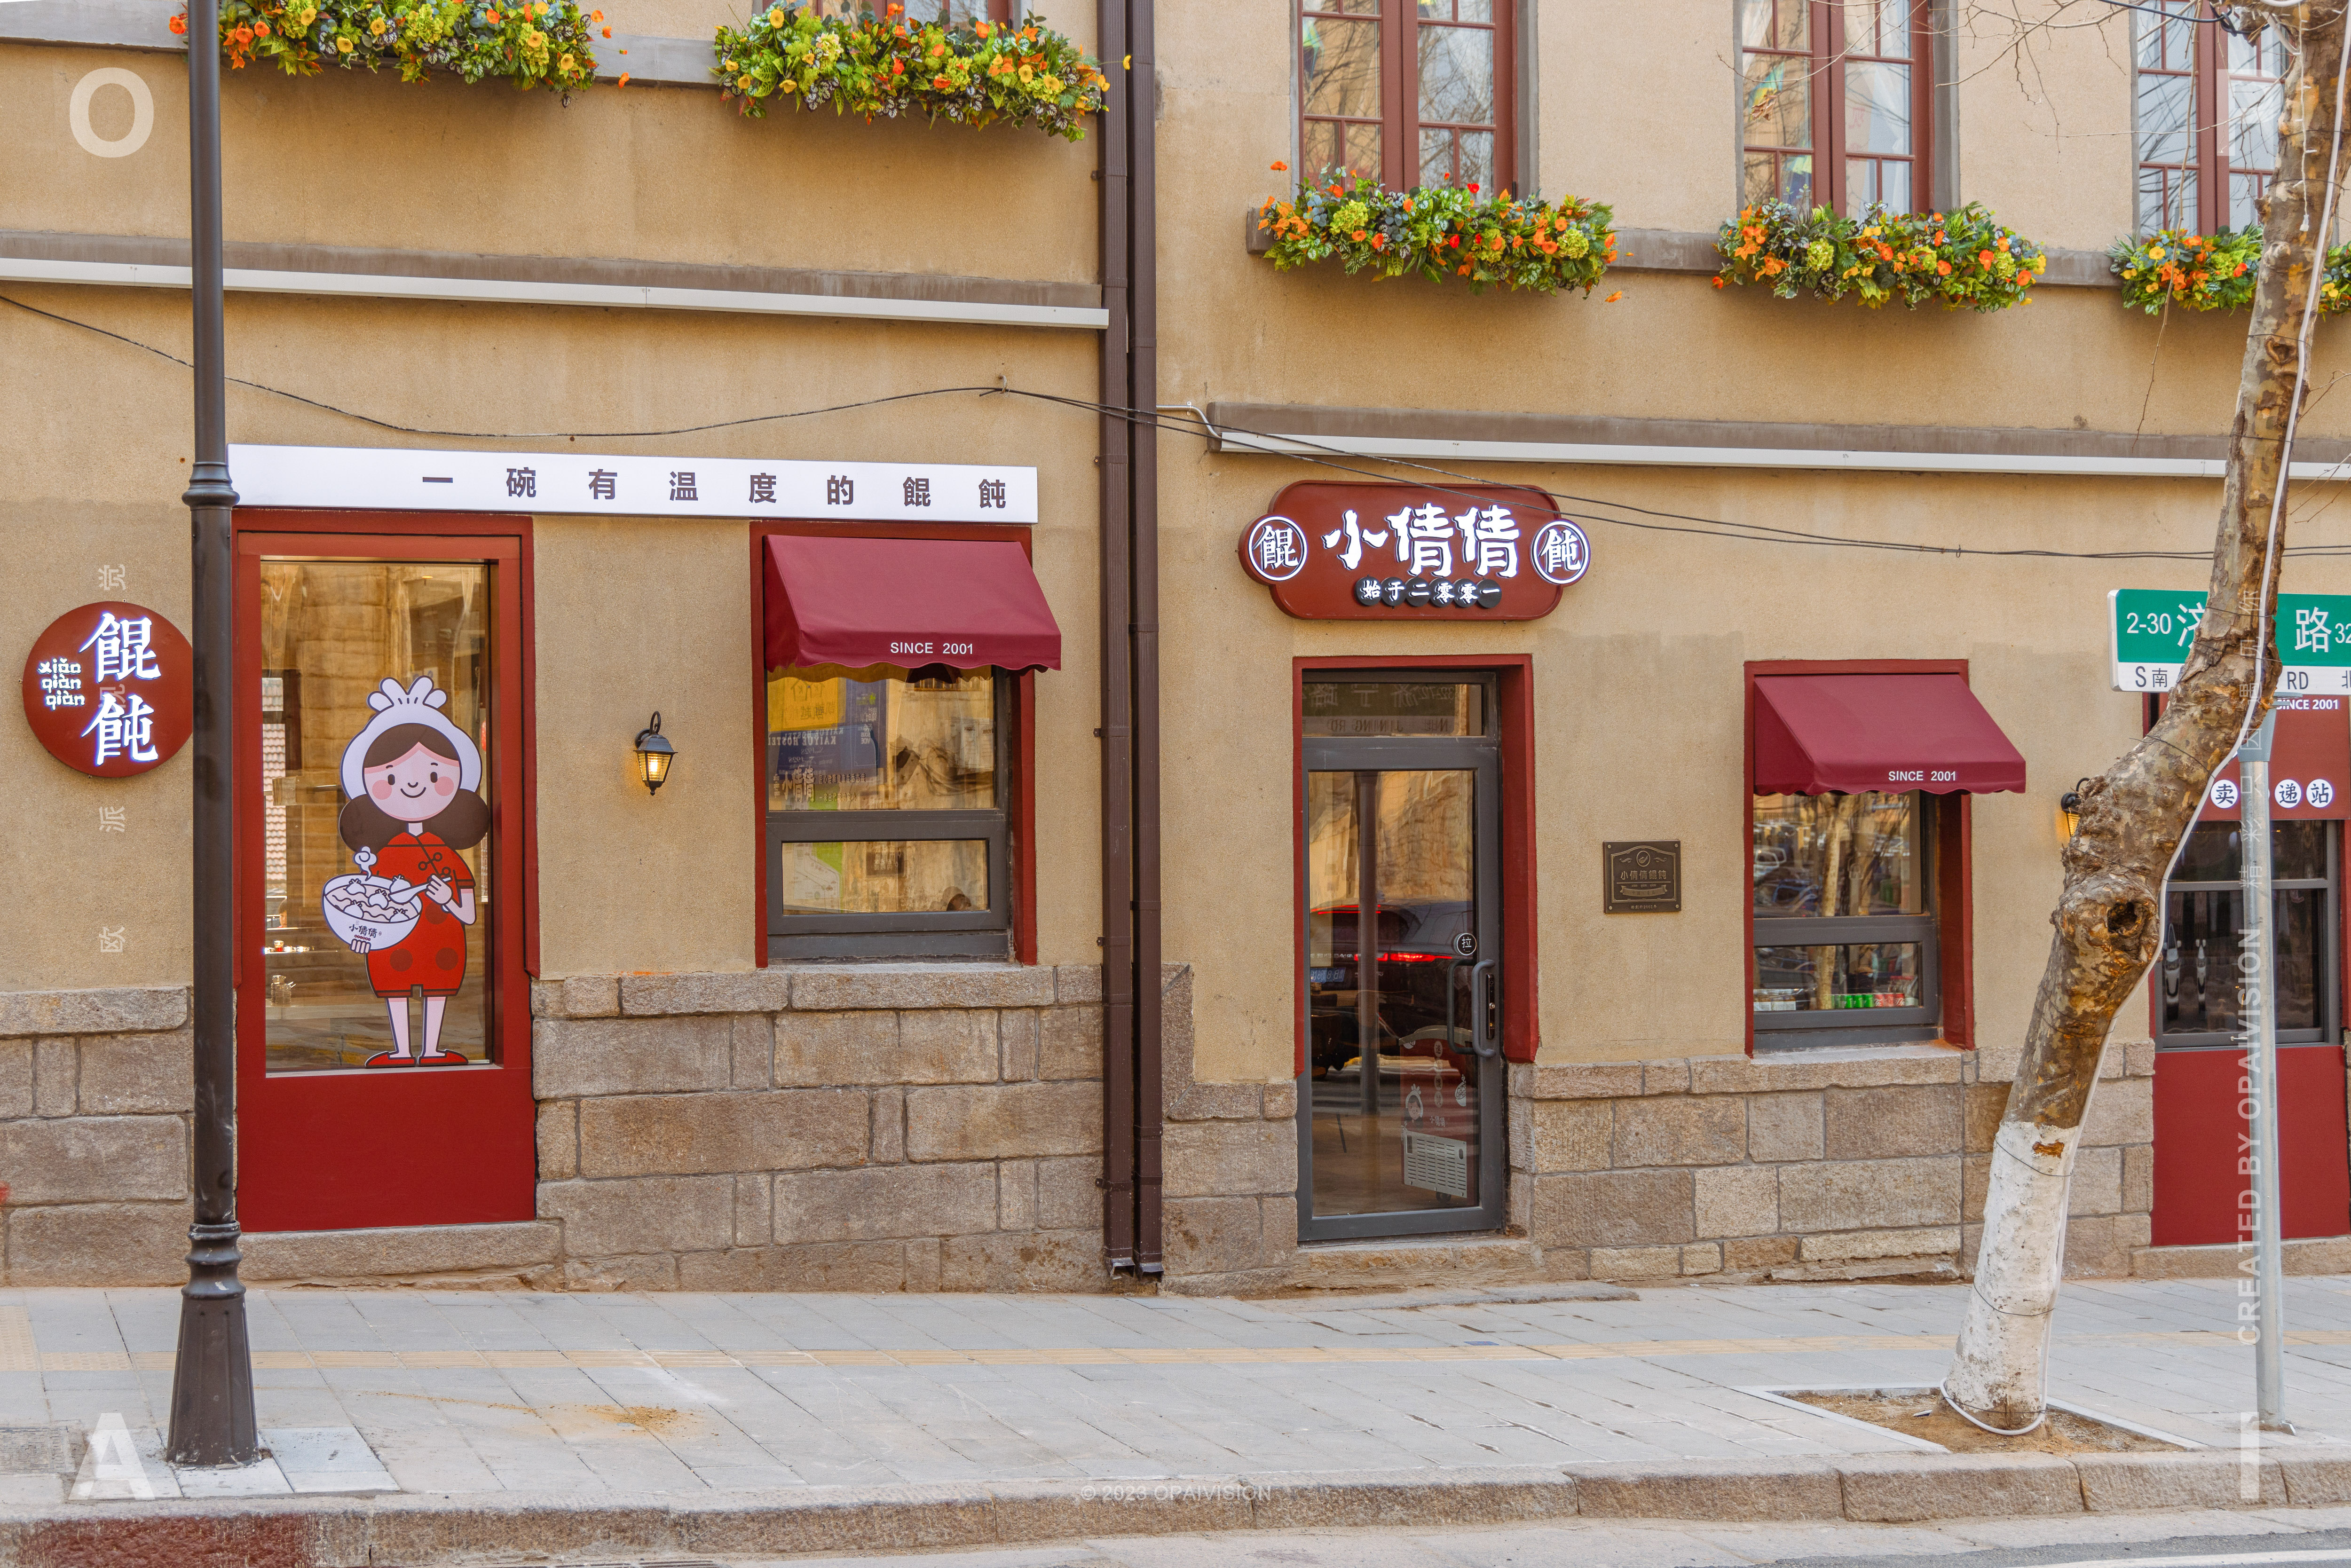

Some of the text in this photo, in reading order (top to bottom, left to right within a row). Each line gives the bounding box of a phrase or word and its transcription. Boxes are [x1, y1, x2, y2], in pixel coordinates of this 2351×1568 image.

[1321, 503, 1519, 578] 小倩倩
[1362, 582, 1500, 604] 始于二零零一
[2126, 612, 2171, 635] 2-30
[890, 642, 973, 654] SINCE 2001
[79, 612, 162, 766] 餛飩
[2287, 671, 2309, 690] RD
[2276, 699, 2339, 710] SINCE 2001
[1888, 771, 1956, 781] SINCE 2001
[2215, 782, 2329, 804] 卖递站
[349, 923, 378, 938] 小倩倩
[1461, 937, 1472, 948] 拉
